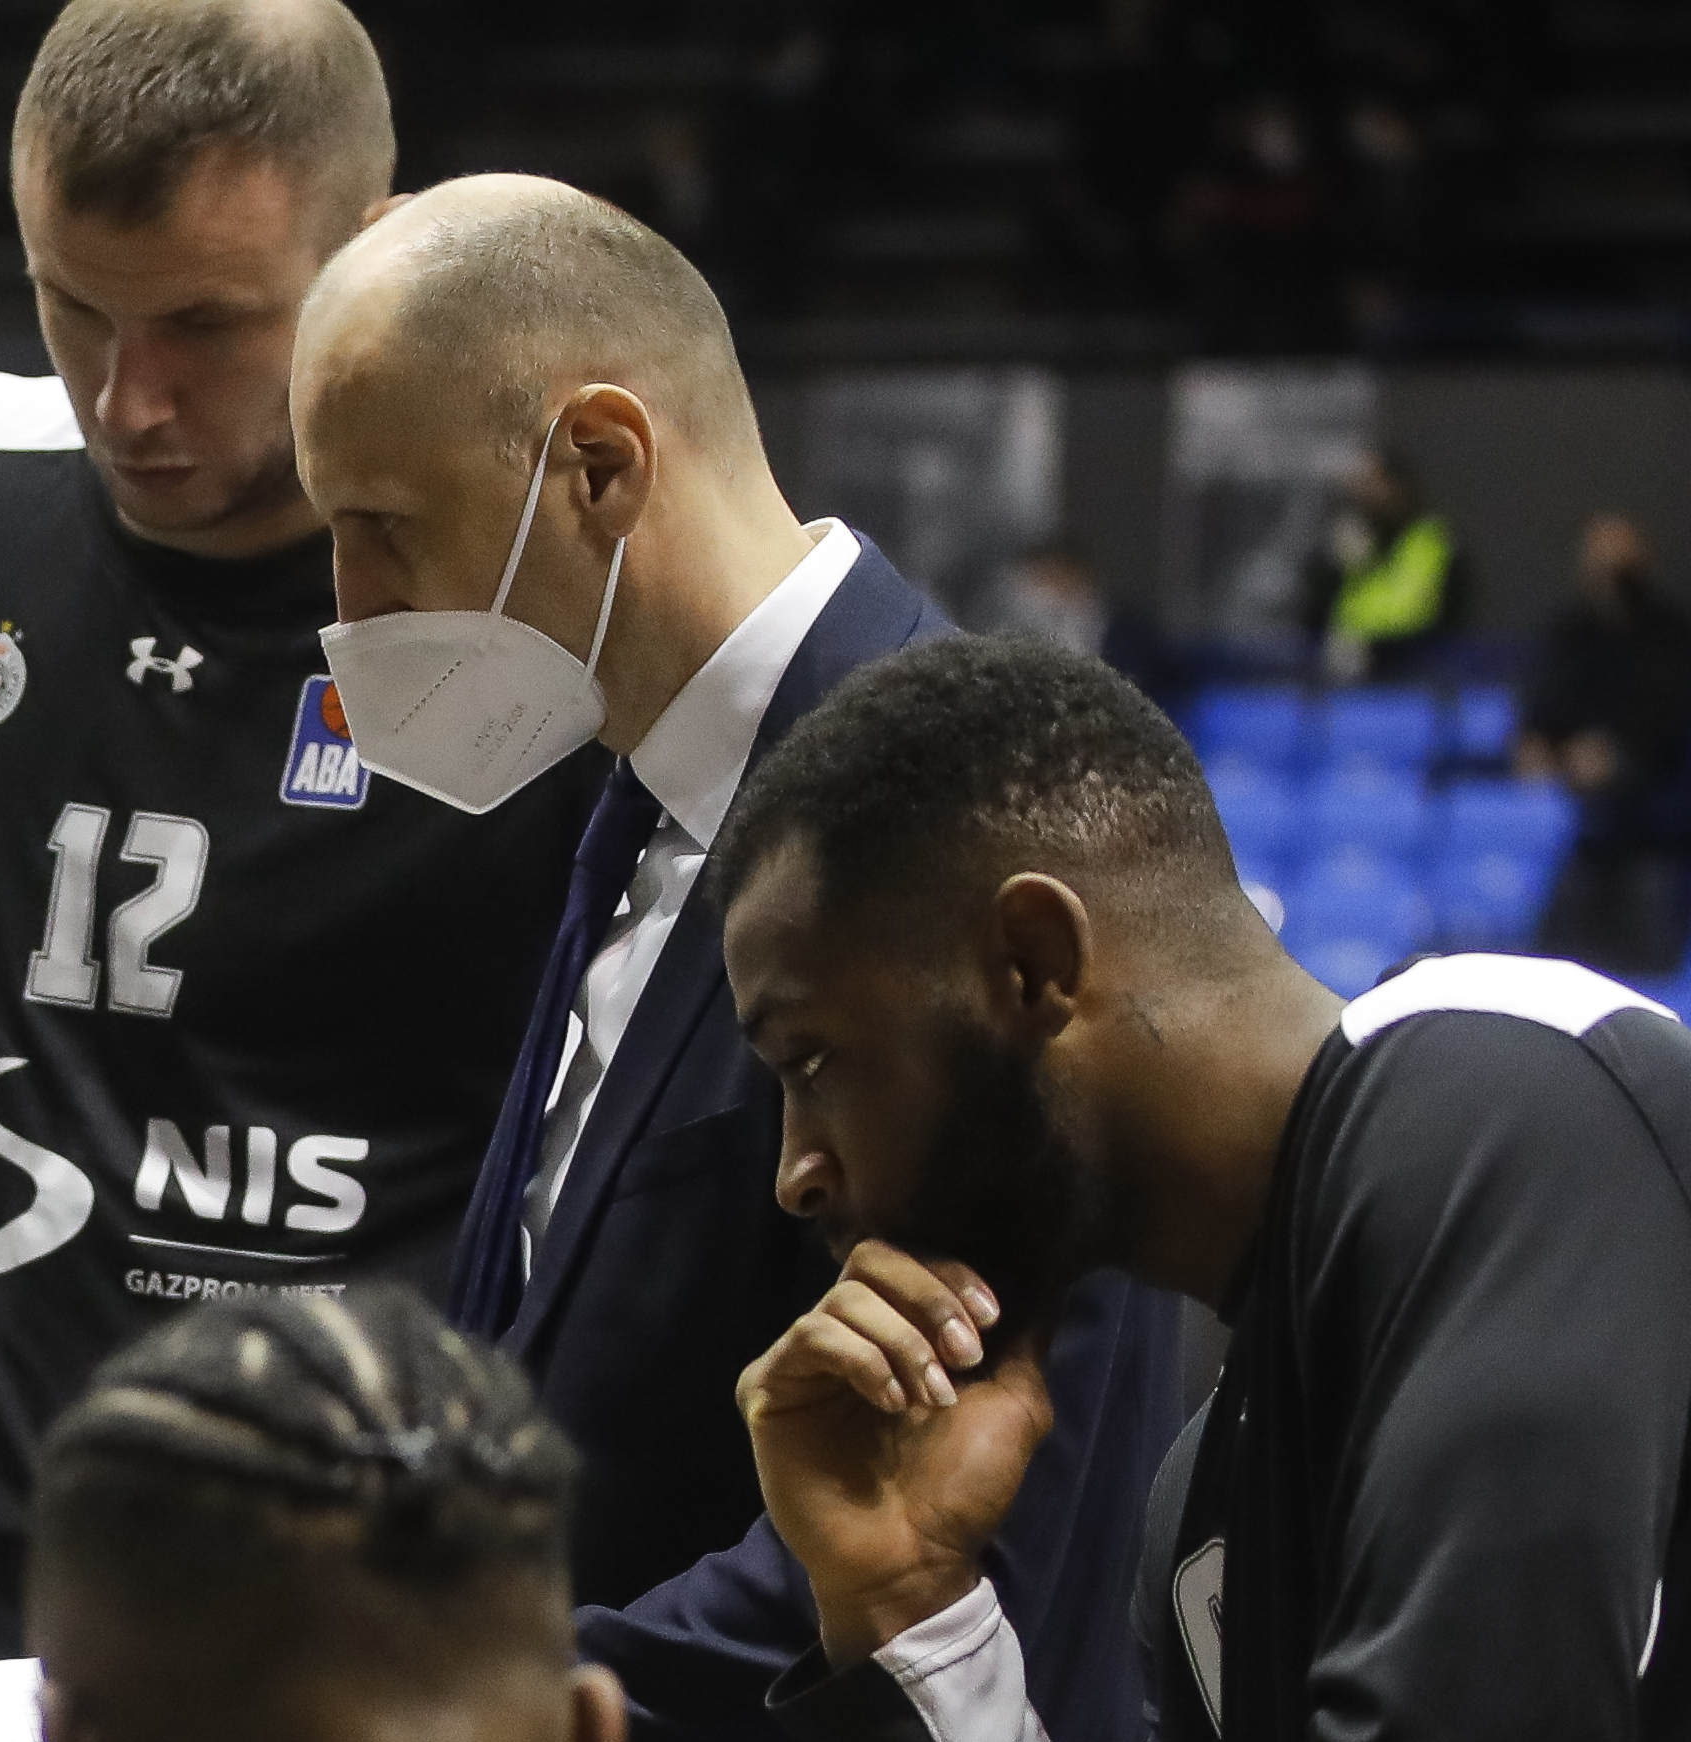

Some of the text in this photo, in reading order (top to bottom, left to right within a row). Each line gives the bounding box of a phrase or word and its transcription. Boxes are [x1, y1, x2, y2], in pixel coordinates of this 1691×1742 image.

[291, 741, 358, 796] ABA
[24, 802, 210, 1018] 12
[134, 1118, 370, 1234] NIS
